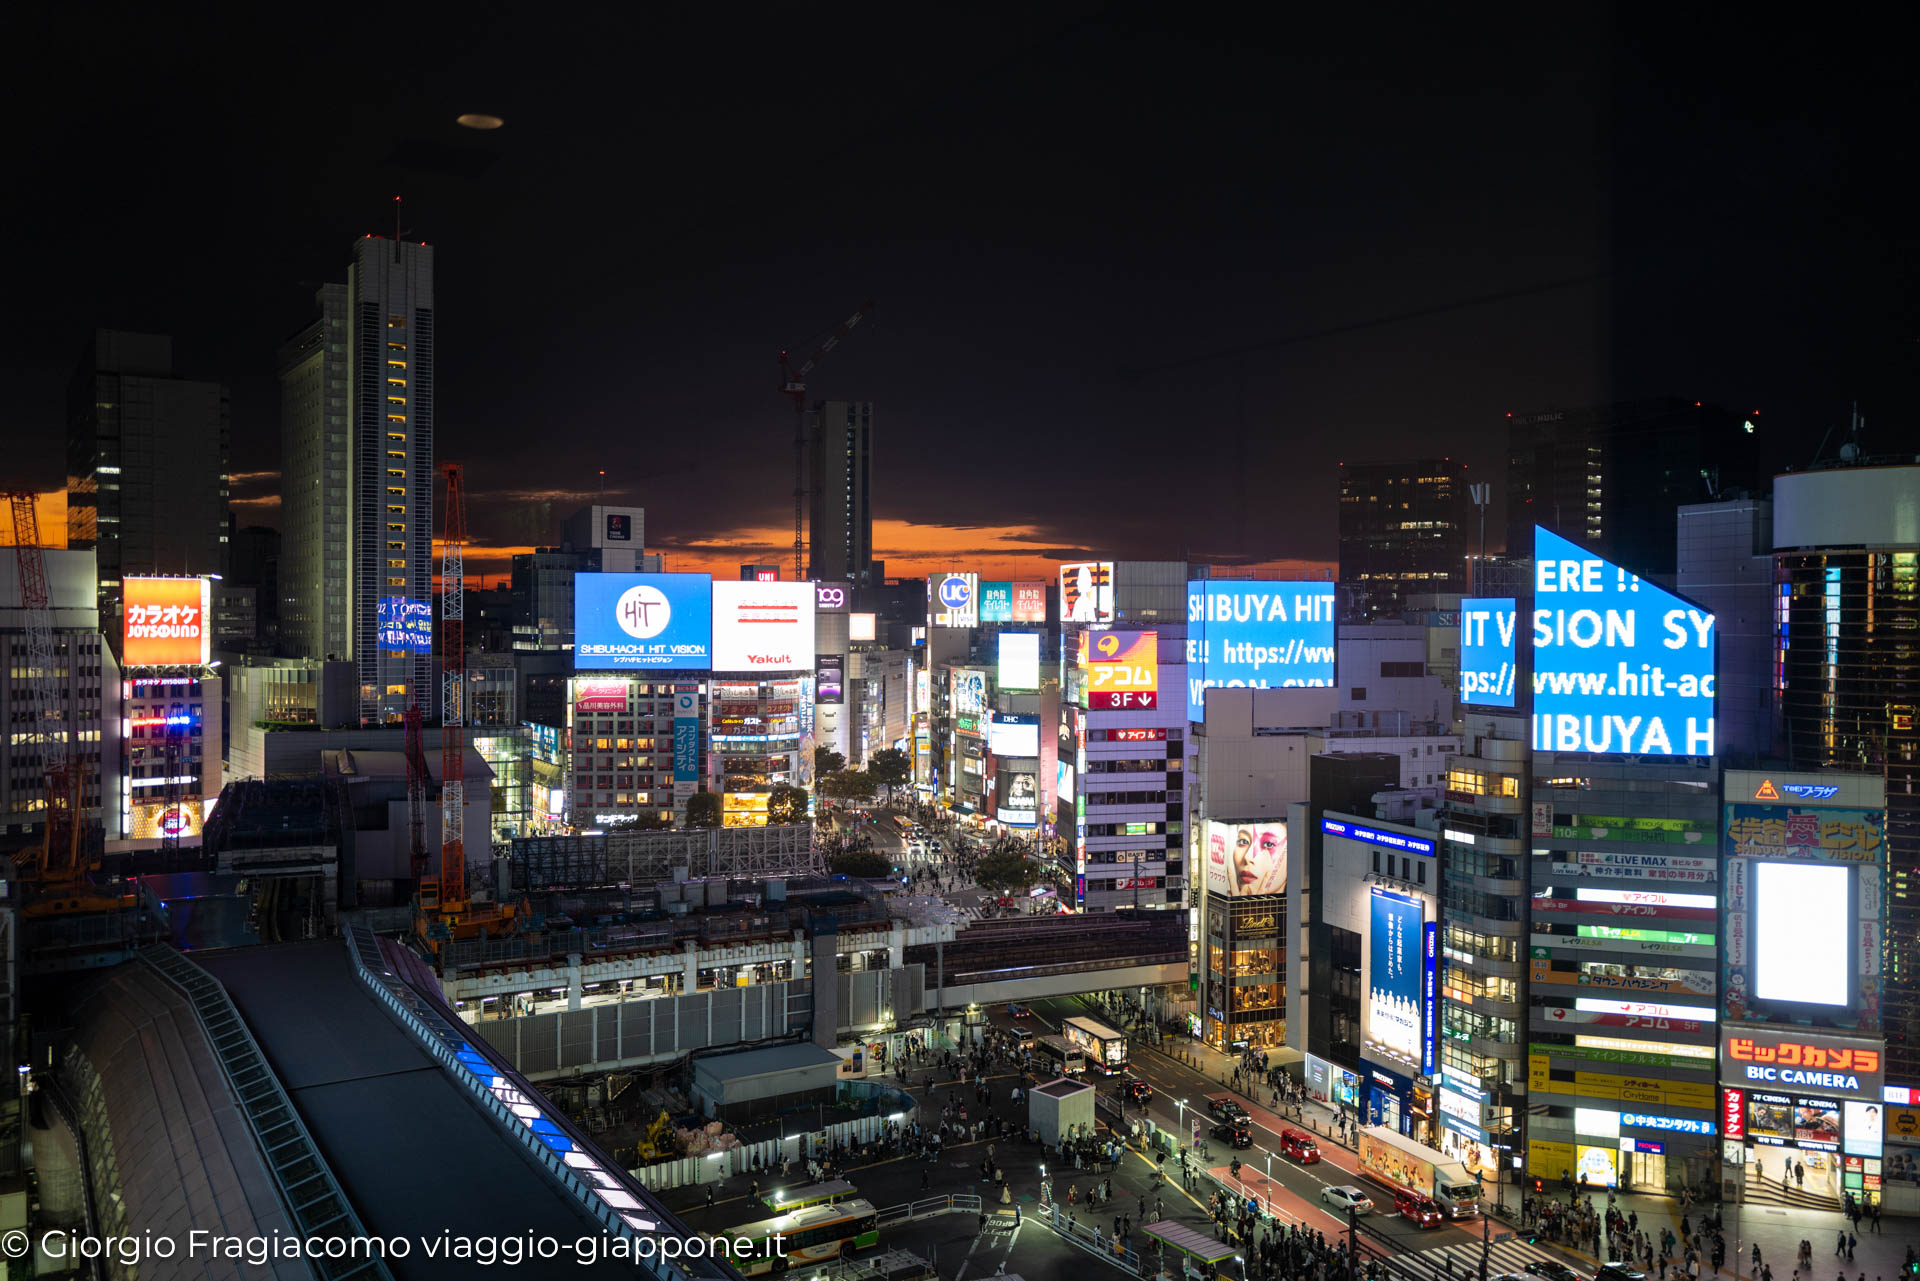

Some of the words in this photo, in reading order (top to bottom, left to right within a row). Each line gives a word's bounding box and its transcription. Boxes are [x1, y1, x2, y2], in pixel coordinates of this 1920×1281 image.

[1536, 559, 1604, 592] ERE
[816, 588, 844, 608] 109
[128, 604, 199, 624] カラオケ
[1188, 594, 1287, 622] SHIBUYA
[1296, 594, 1335, 622] HIT
[128, 624, 200, 638] JOYSOUND
[1533, 608, 1636, 648] SION
[1662, 610, 1715, 650] SY
[580, 644, 644, 654] SHIBUHACHI
[648, 645, 666, 654] HIT
[670, 645, 705, 654] VISION
[747, 654, 792, 664] Yakult
[1093, 666, 1152, 686] アコム
[1110, 692, 1133, 706] 3F
[733, 726, 755, 734] ガスト
[1533, 713, 1672, 755] IBUYA
[676, 725, 687, 772] アイシティ
[688, 725, 696, 772] コンタクトの
[1326, 822, 1346, 832] MIZUHO
[1641, 856, 1667, 866] MAX
[1797, 848, 1811, 857] AI
[1826, 850, 1876, 862] VISION
[1595, 867, 1642, 877] 仲介手数料
[1648, 870, 1705, 880] 家賃の半月分
[1633, 893, 1667, 903] アイフル
[1622, 905, 1657, 916] アイフル
[1240, 917, 1267, 929] Lindt
[1562, 937, 1603, 947] レイクALSA
[1683, 933, 1698, 943] 7F
[1641, 943, 1682, 952] レイクALSA
[1535, 972, 1545, 980] 6F
[1635, 1004, 1669, 1016] アコム
[1624, 1016, 1670, 1030] アコム
[1684, 1021, 1699, 1031] 5F
[1591, 1050, 1666, 1066] マインドフルネス
[1728, 1037, 1880, 1073] ビックカメラ
[1372, 1070, 1394, 1086] MIZUHO
[1624, 1080, 1660, 1089] シティホーム
[1746, 1065, 1777, 1081] BIC
[1780, 1068, 1860, 1090] CAMERA
[1762, 1094, 1790, 1104] CINEMA
[1808, 1100, 1838, 1109] CINEMA
[1728, 1092, 1740, 1133] カラオケ
[1636, 1115, 1700, 1132] 中央コンタクト
[1796, 1130, 1814, 1139] RED
